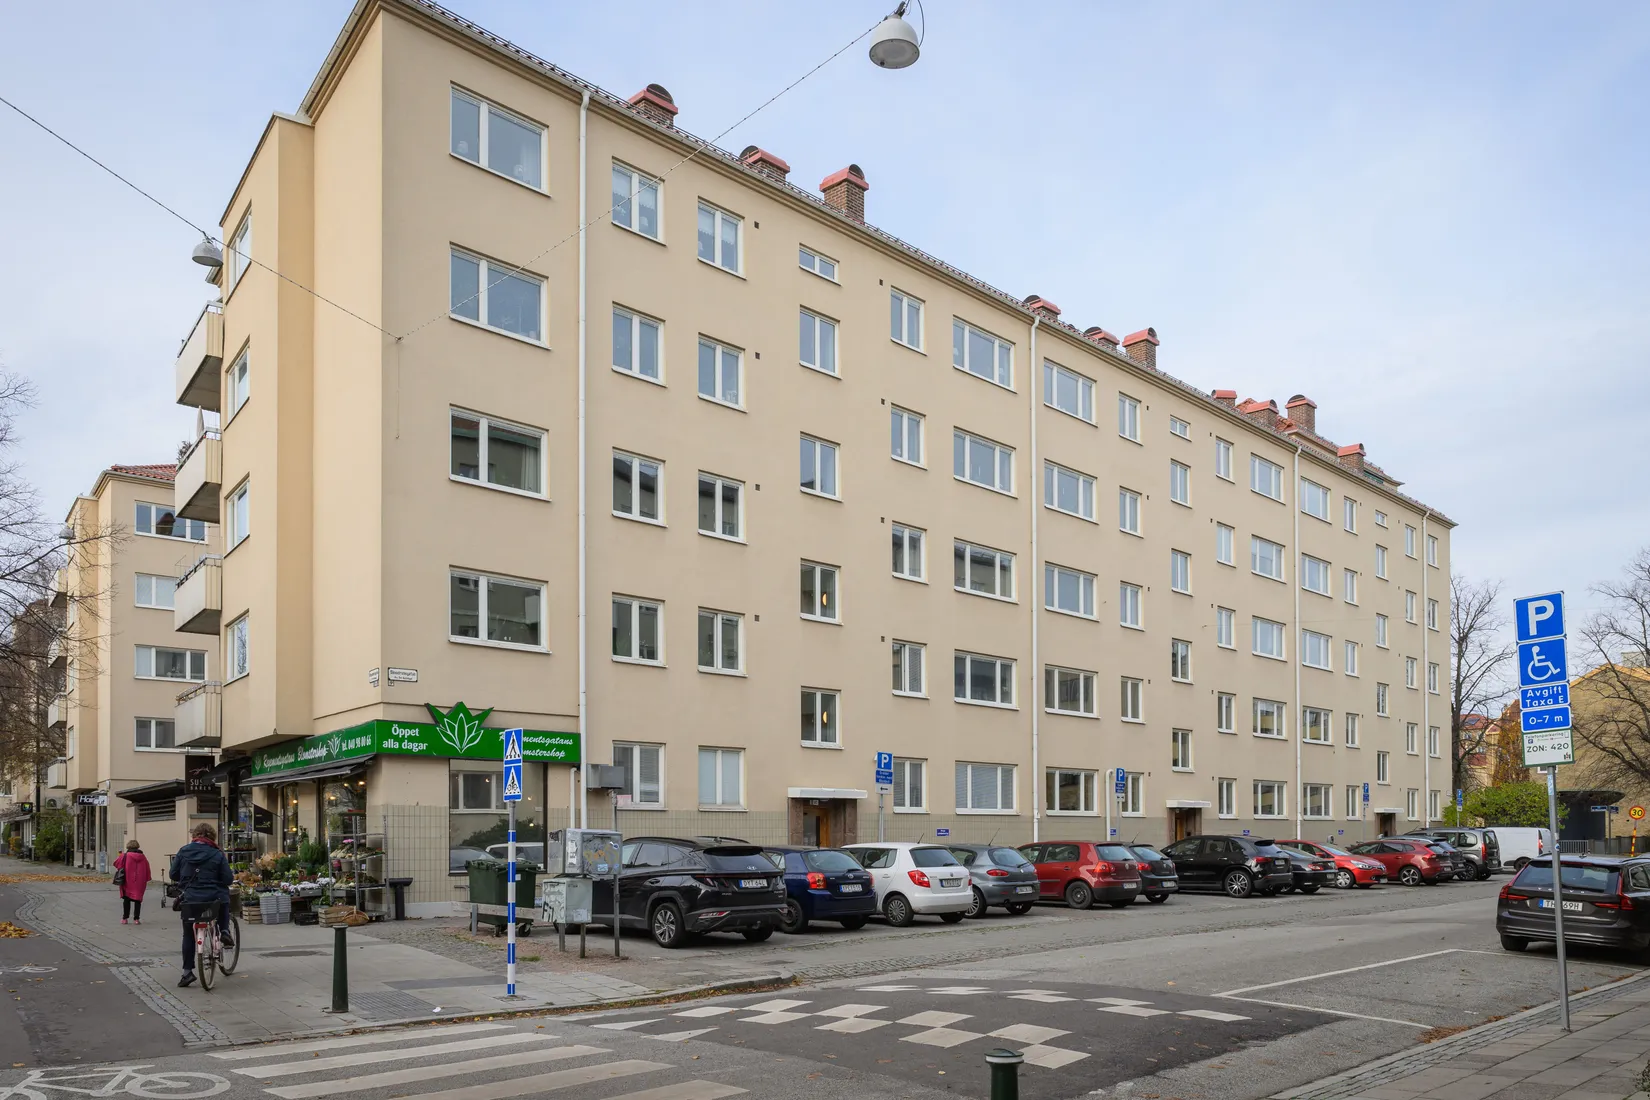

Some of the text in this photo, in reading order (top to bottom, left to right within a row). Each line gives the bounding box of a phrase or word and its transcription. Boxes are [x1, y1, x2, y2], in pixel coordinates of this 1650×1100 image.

[1528, 599, 1555, 636] P
[1527, 686, 1562, 698] Avgift
[1526, 695, 1564, 708] Taxa E
[391, 723, 420, 738] Öppet
[382, 739, 429, 752] alla dagar
[498, 731, 573, 747] Rmentsgatans
[1526, 742, 1570, 753] ZON: 420
[881, 753, 890, 769] P
[1118, 769, 1124, 781] P
[1631, 808, 1643, 817] 30
[1563, 902, 1580, 910] 69H
